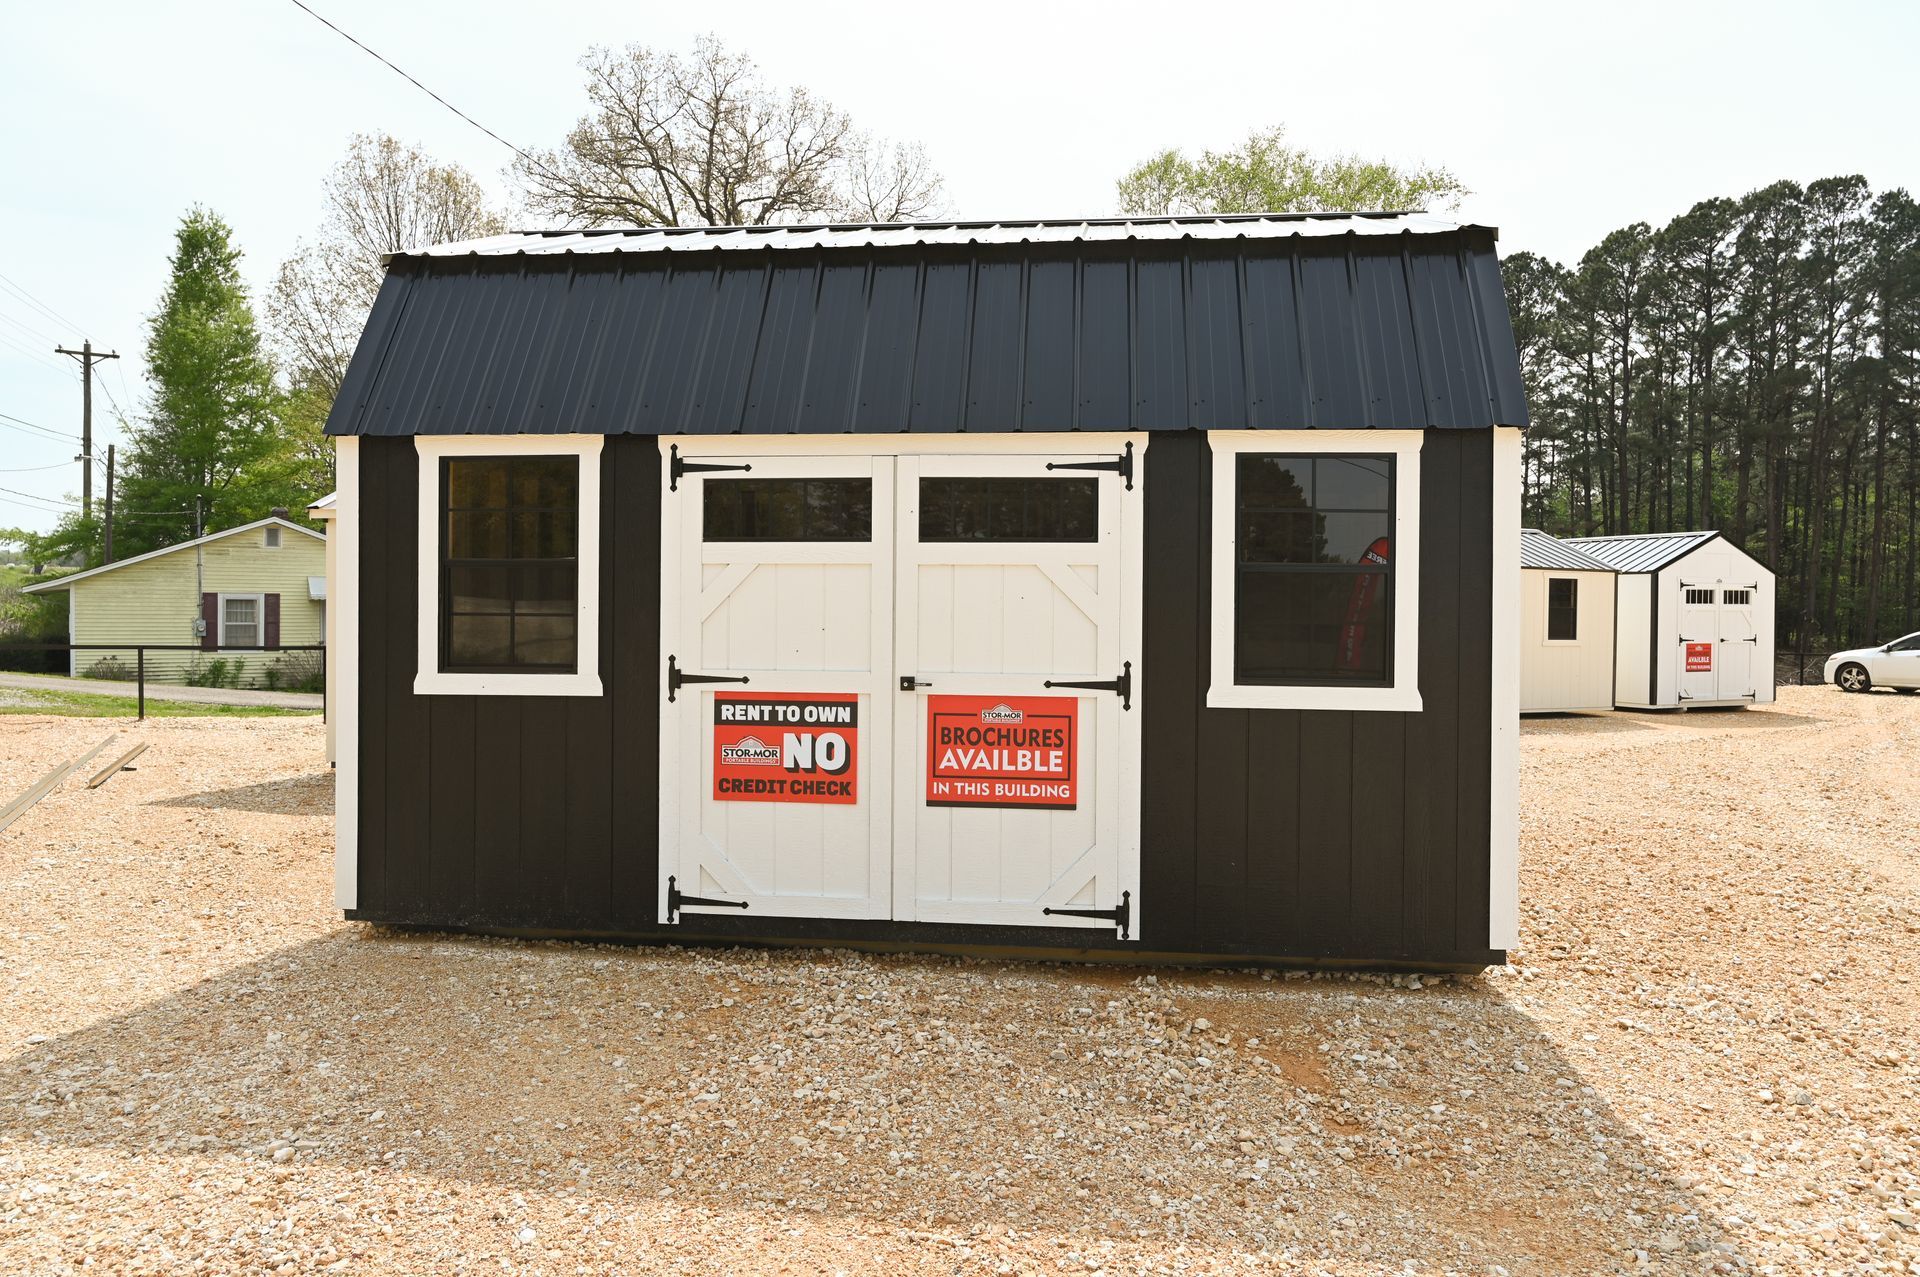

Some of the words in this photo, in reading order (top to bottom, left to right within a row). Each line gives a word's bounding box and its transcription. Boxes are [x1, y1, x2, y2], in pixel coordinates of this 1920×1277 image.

[721, 704, 773, 721] RENT
[775, 705, 800, 722] TO
[804, 706, 851, 723] OWN
[982, 711, 1021, 719] STOR-MOR
[940, 727, 1064, 748] BROCHURES
[723, 748, 778, 758] STOR-MOR
[783, 732, 849, 774] NO
[938, 748, 1063, 772] AVAILBLE
[718, 778, 787, 794] CREDIT
[790, 779, 852, 796] CHECK
[933, 782, 949, 795] IN
[954, 782, 989, 796] THIS
[995, 783, 1070, 798] BUILDING
